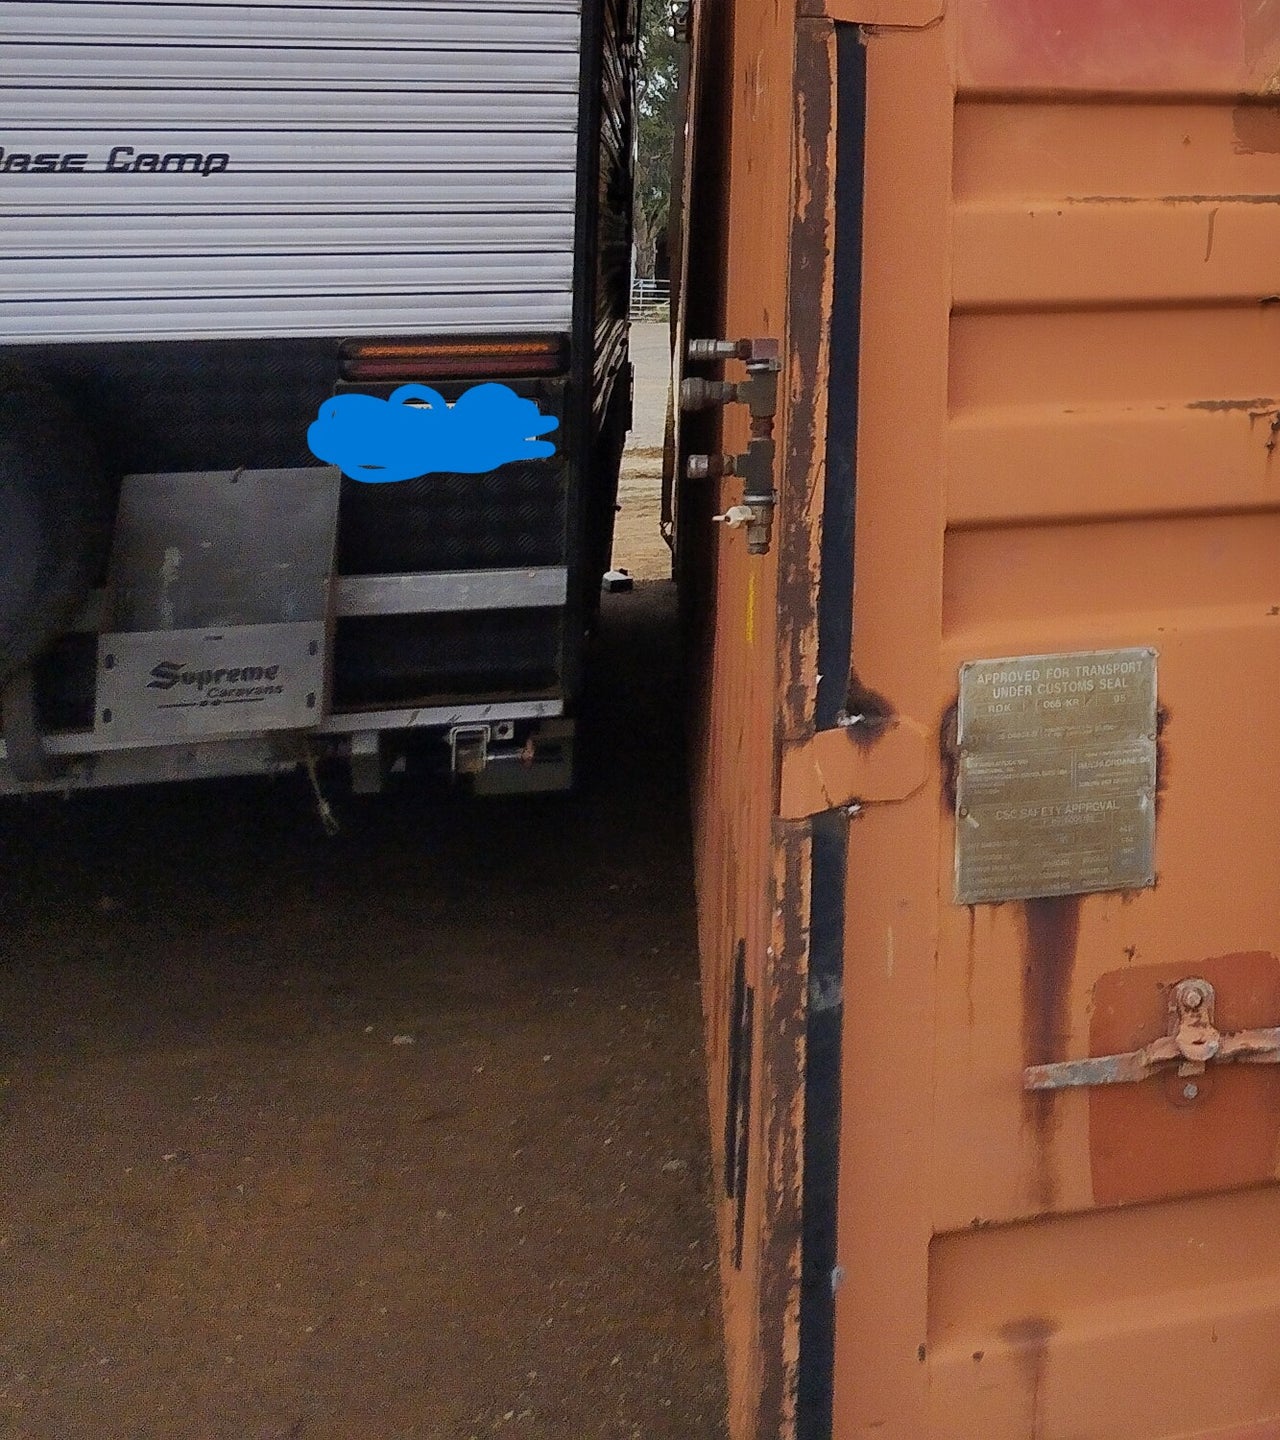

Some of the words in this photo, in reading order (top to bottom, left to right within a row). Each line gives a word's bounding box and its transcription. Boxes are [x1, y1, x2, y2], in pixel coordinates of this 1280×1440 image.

[105, 146, 230, 177] Camp
[146, 660, 280, 691] Supreme
[975, 668, 1041, 685] APPROVED
[1046, 665, 1071, 679] FOR
[1075, 660, 1144, 677] TRANSPORT
[206, 685, 284, 699] Caravans
[993, 682, 1033, 699] UNDER
[1037, 679, 1095, 696] CUSTOMS
[1099, 676, 1129, 690] SEAL
